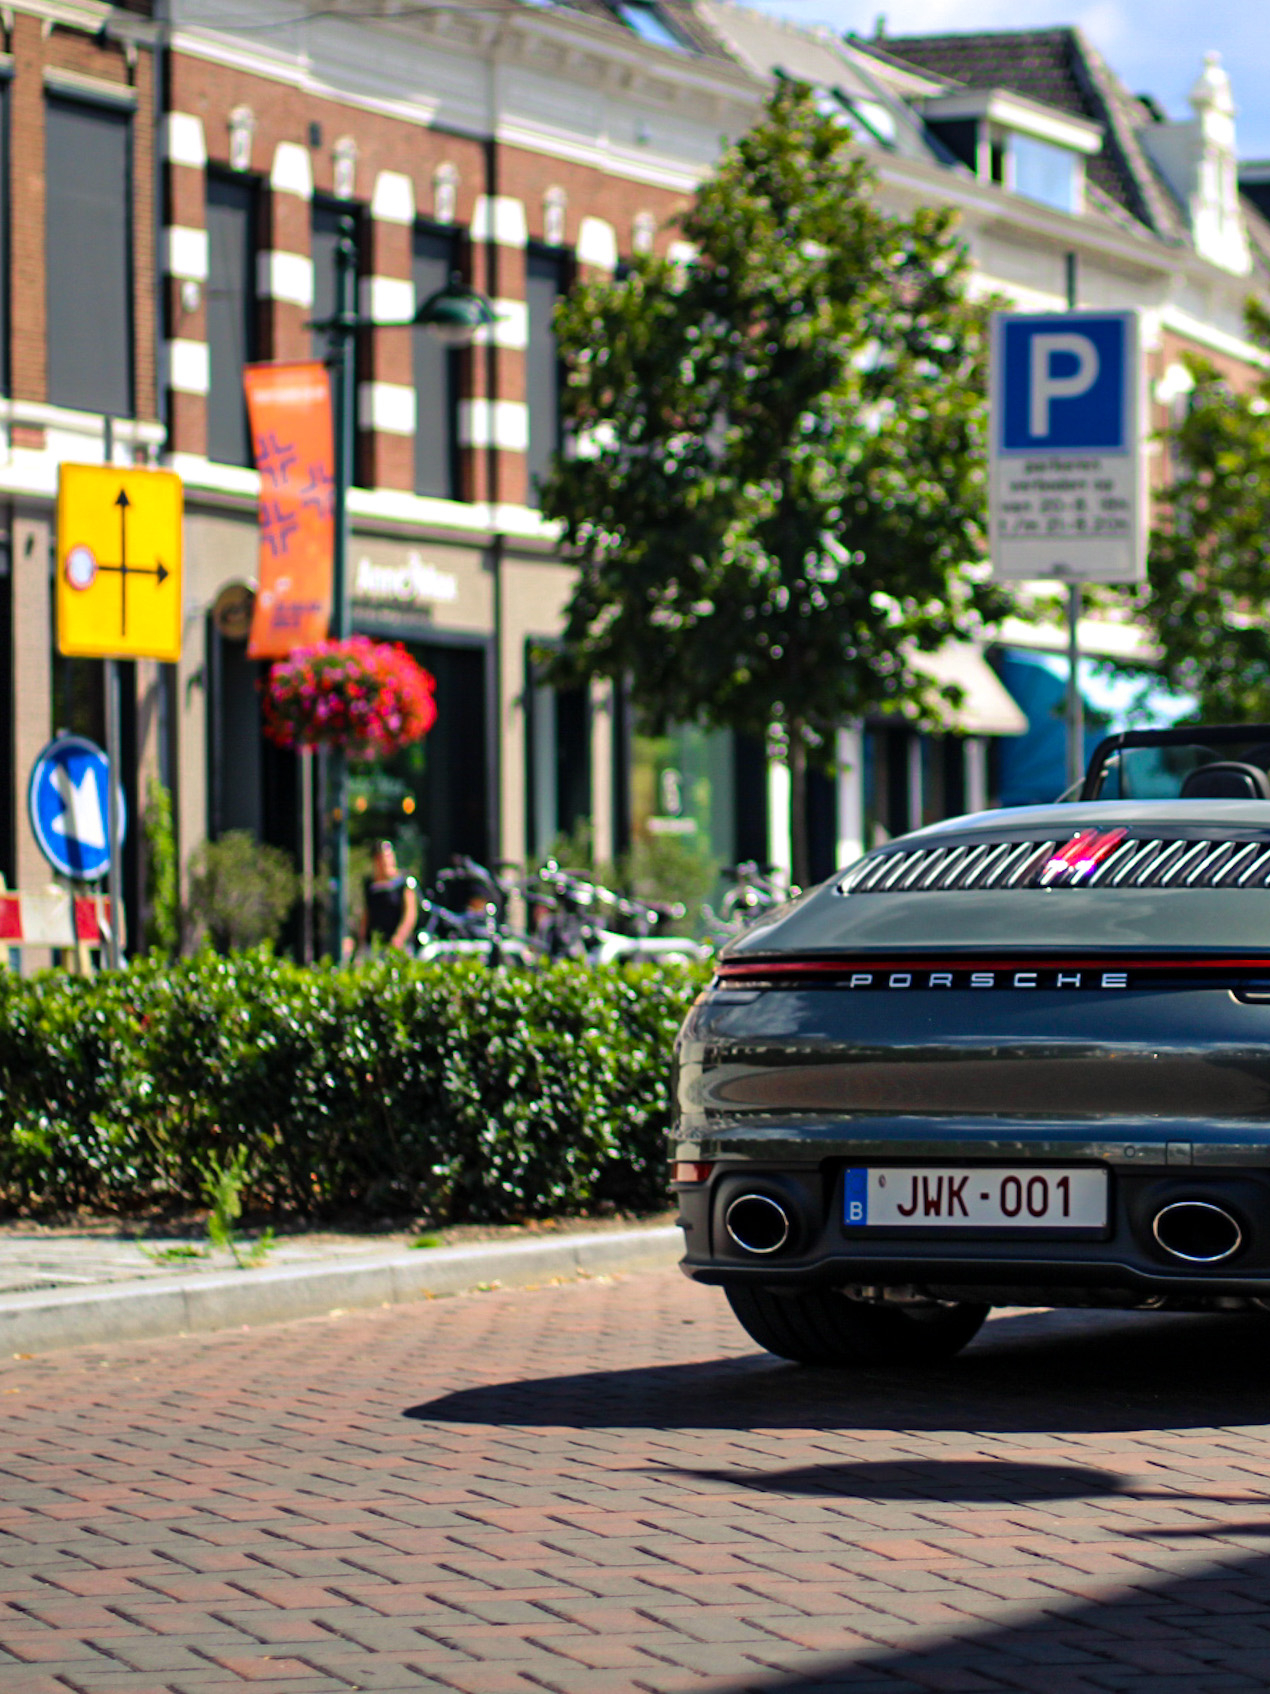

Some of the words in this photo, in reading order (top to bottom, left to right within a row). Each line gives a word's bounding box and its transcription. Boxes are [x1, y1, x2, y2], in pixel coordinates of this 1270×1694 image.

[1029, 332, 1100, 438] P
[849, 973, 1128, 989] PORSCHE
[850, 1201, 863, 1221] B
[896, 1174, 1071, 1218] JWK-001
